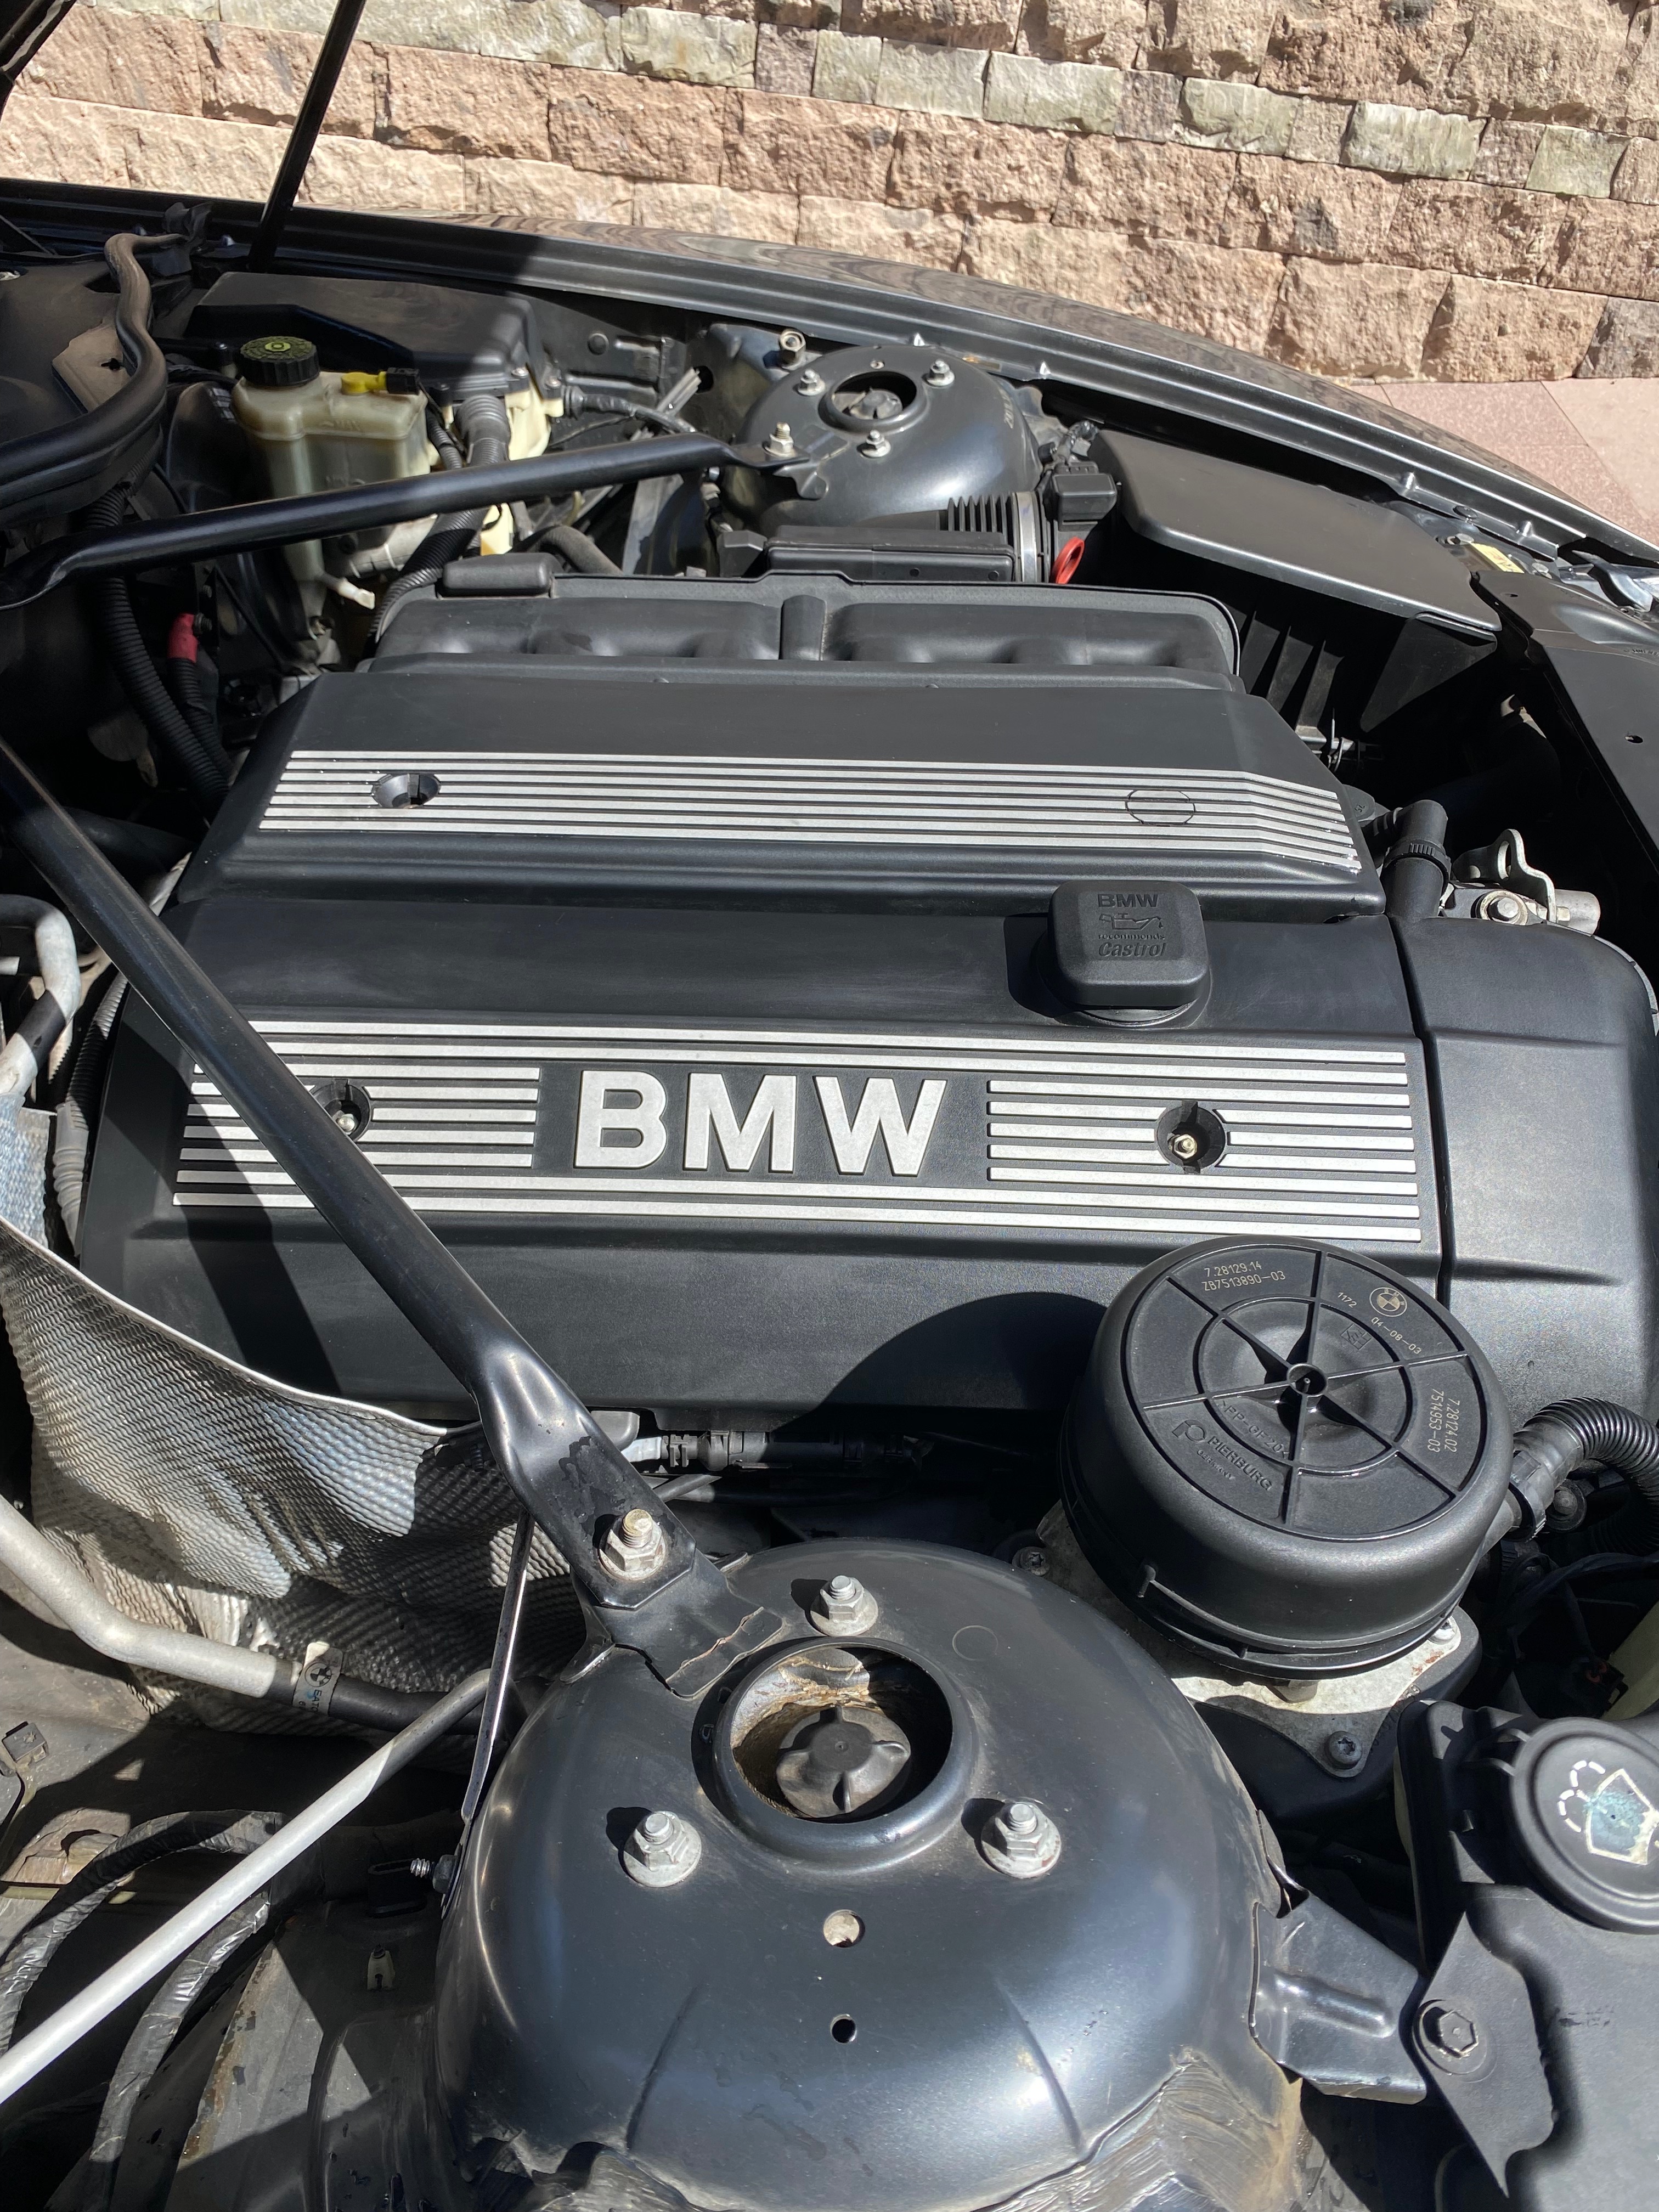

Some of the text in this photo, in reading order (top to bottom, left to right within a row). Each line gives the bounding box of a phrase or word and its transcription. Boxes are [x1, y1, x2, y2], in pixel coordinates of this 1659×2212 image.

[1098, 894, 1159, 908] BMW
[1098, 942, 1167, 957] Castrol
[573, 1070, 947, 1177] BMW
[1204, 1261, 1262, 1277] 7.28129.14
[1201, 1270, 1286, 1291] ZB7513890-03
[1338, 1292, 1357, 1308] 1172
[1427, 1389, 1444, 1453] 7514953-03
[1444, 1397, 1460, 1453] 7.28124.02
[1207, 1436, 1272, 1491] PIERBURG
